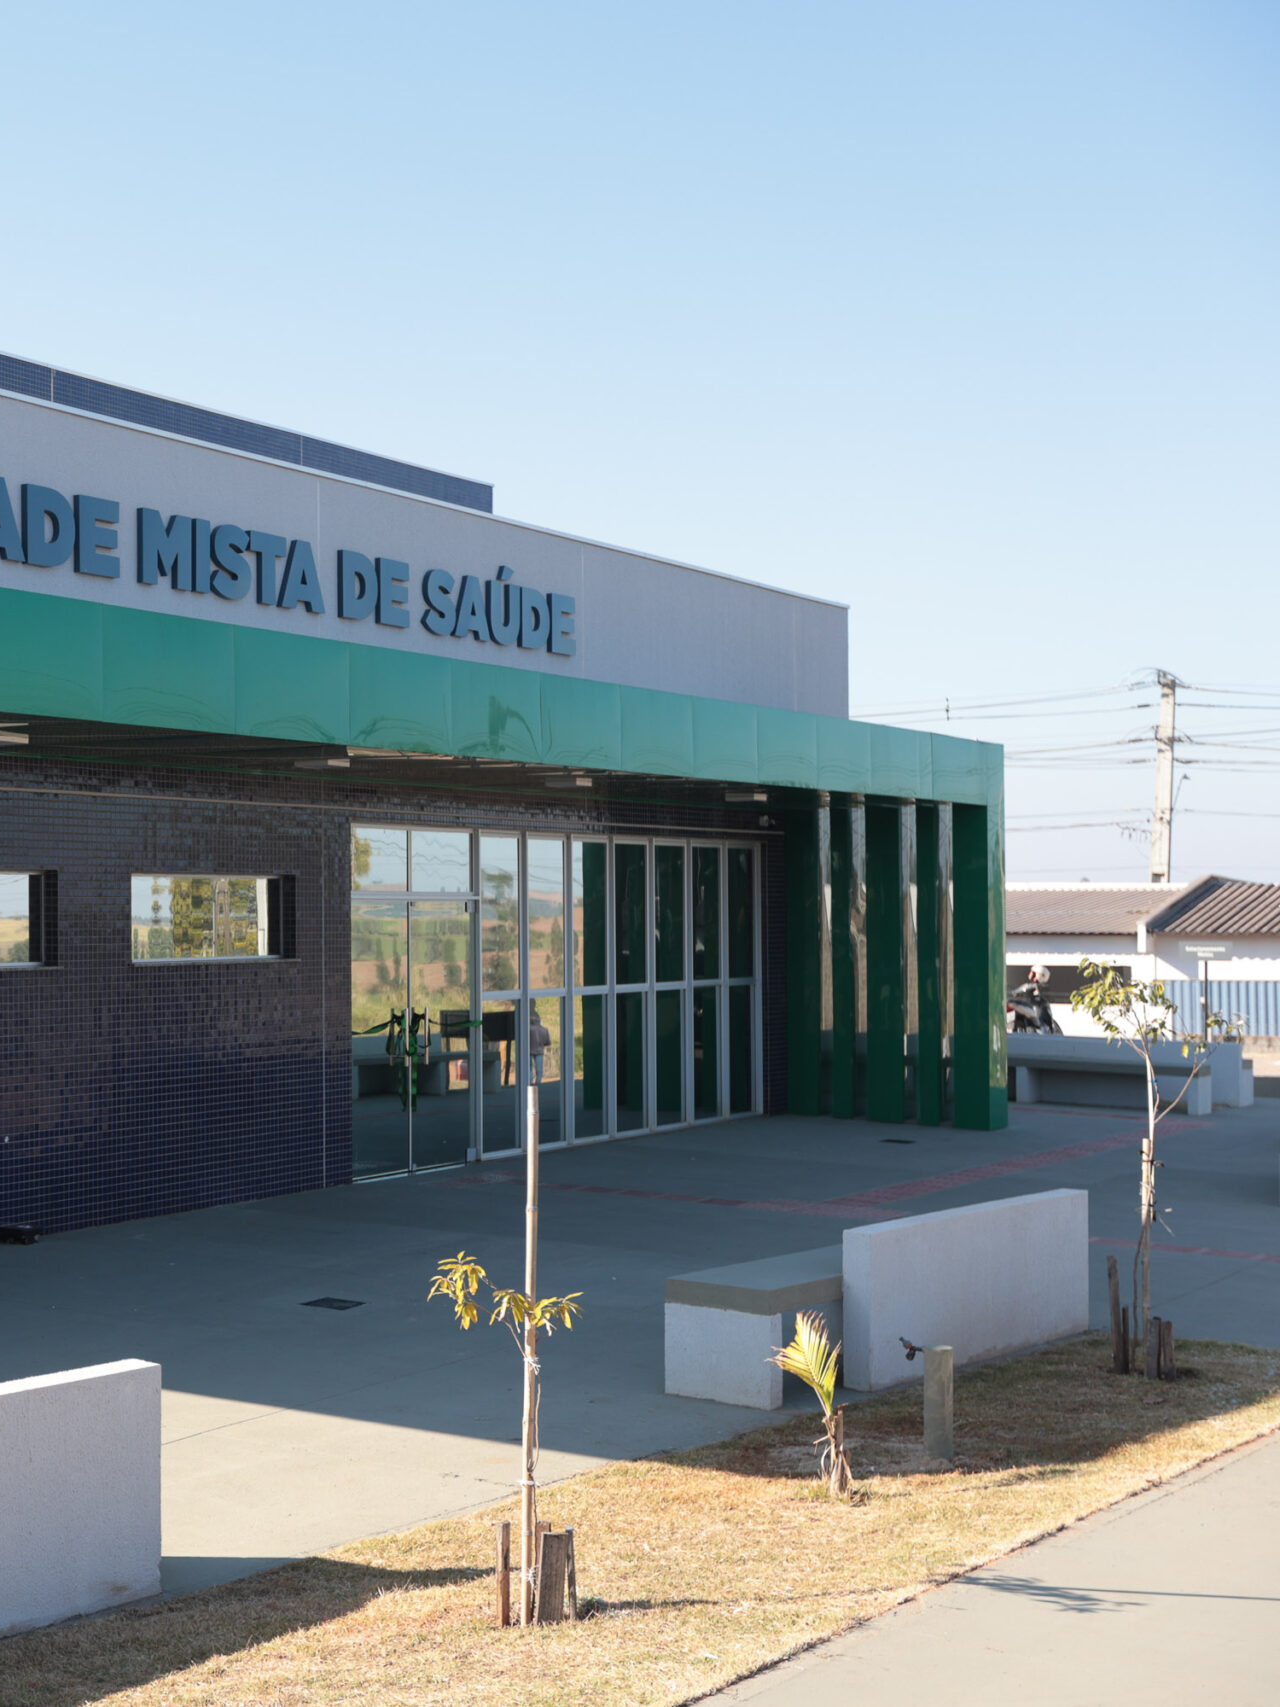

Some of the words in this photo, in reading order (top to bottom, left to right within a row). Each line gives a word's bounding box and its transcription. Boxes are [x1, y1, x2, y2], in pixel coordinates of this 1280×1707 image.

[137, 507, 325, 615] MISTA
[337, 549, 409, 628] DE
[421, 566, 576, 656] SAÚDE
